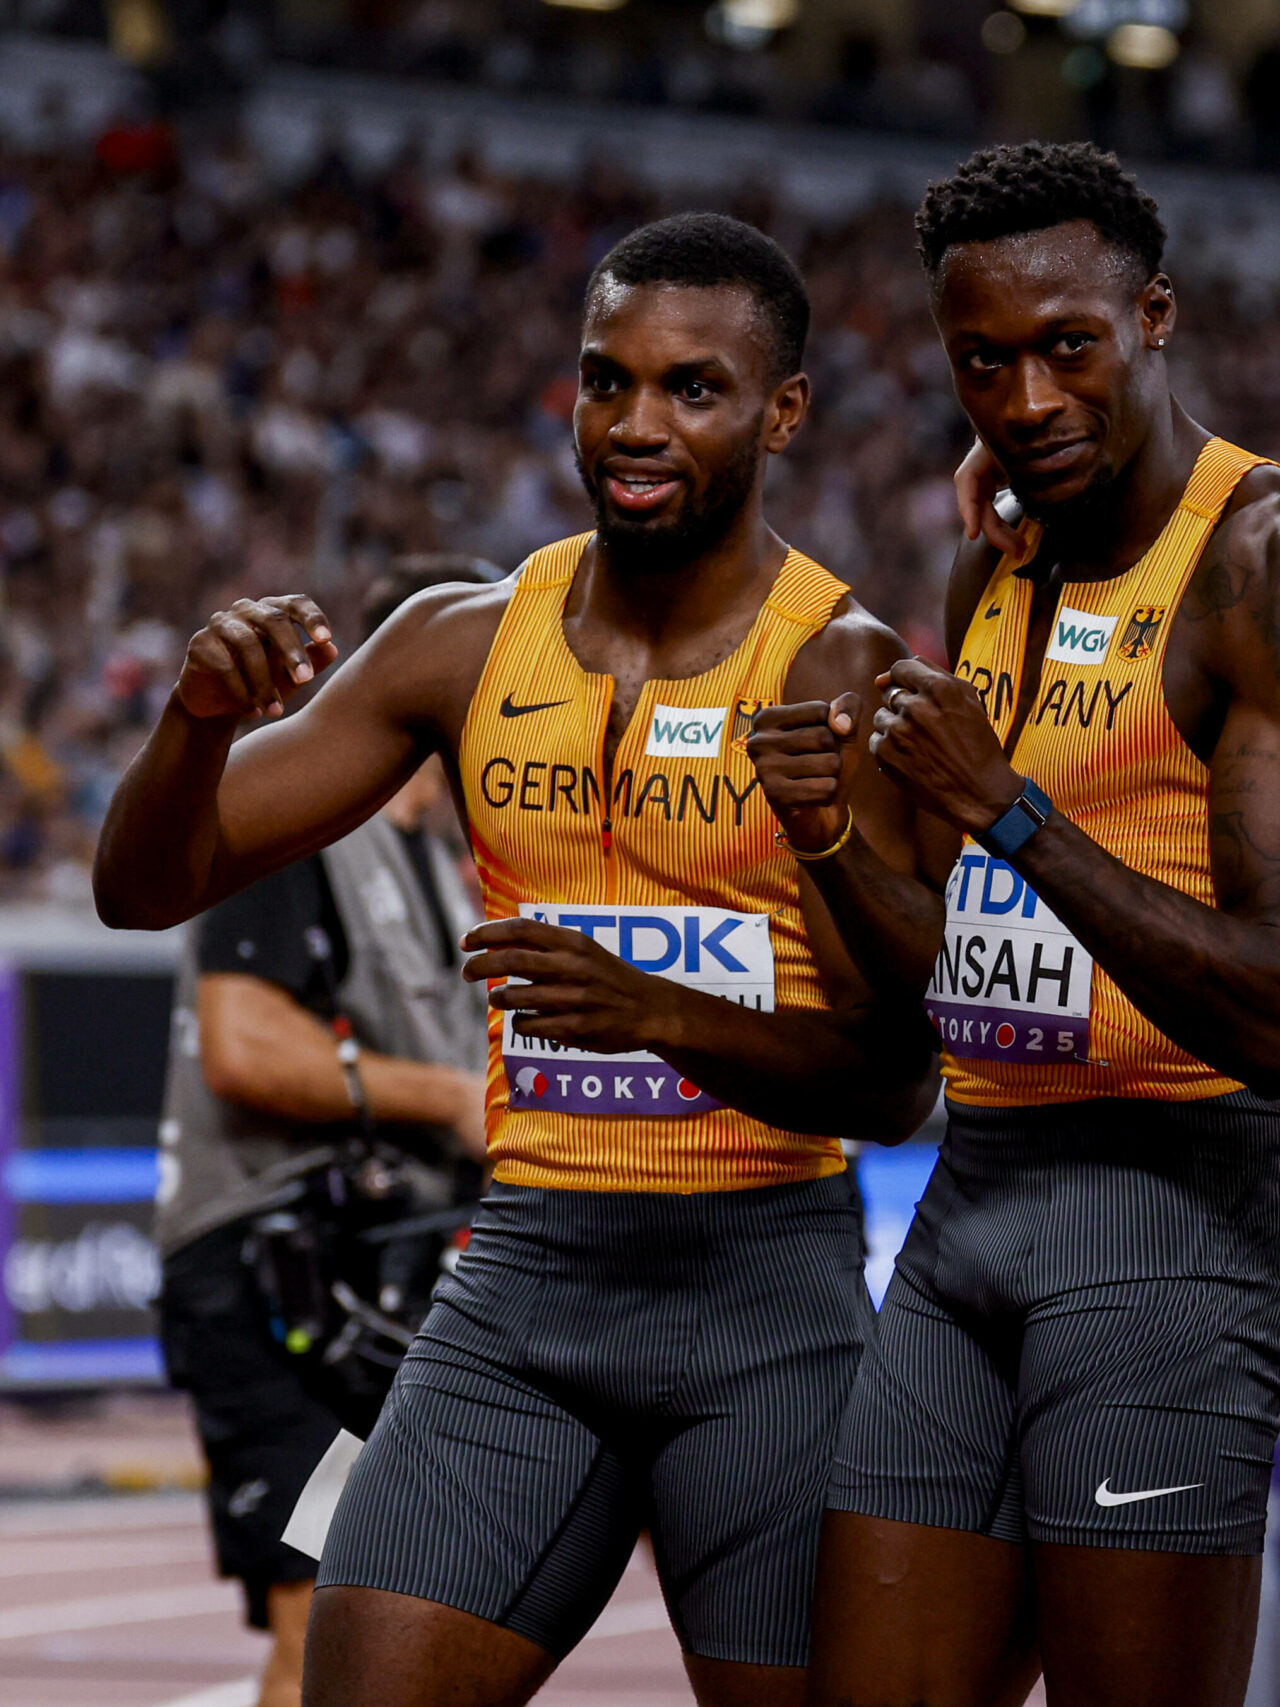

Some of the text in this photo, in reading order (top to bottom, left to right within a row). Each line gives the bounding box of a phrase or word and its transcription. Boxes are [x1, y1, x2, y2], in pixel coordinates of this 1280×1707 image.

[652, 718, 722, 744] WGV
[482, 757, 762, 826] GERMANY
[558, 914, 750, 973] TDK
[1025, 1027, 1075, 1053] 25
